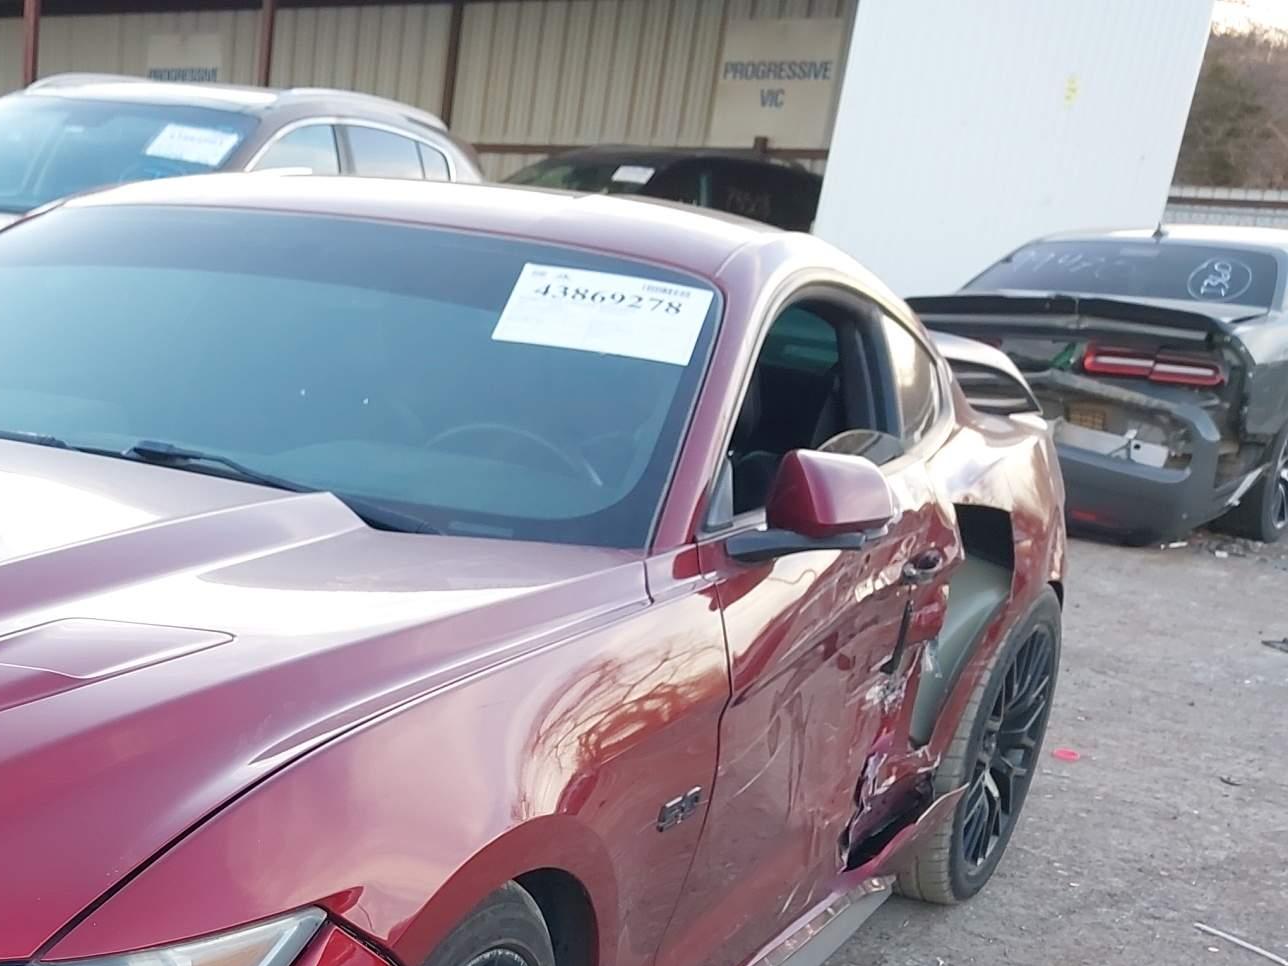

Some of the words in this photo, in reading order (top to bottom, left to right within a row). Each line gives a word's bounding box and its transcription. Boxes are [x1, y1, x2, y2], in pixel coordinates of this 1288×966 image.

[723, 61, 831, 81] PROGRESSIVE
[759, 88, 785, 108] VIC
[534, 283, 683, 315] 43869278
